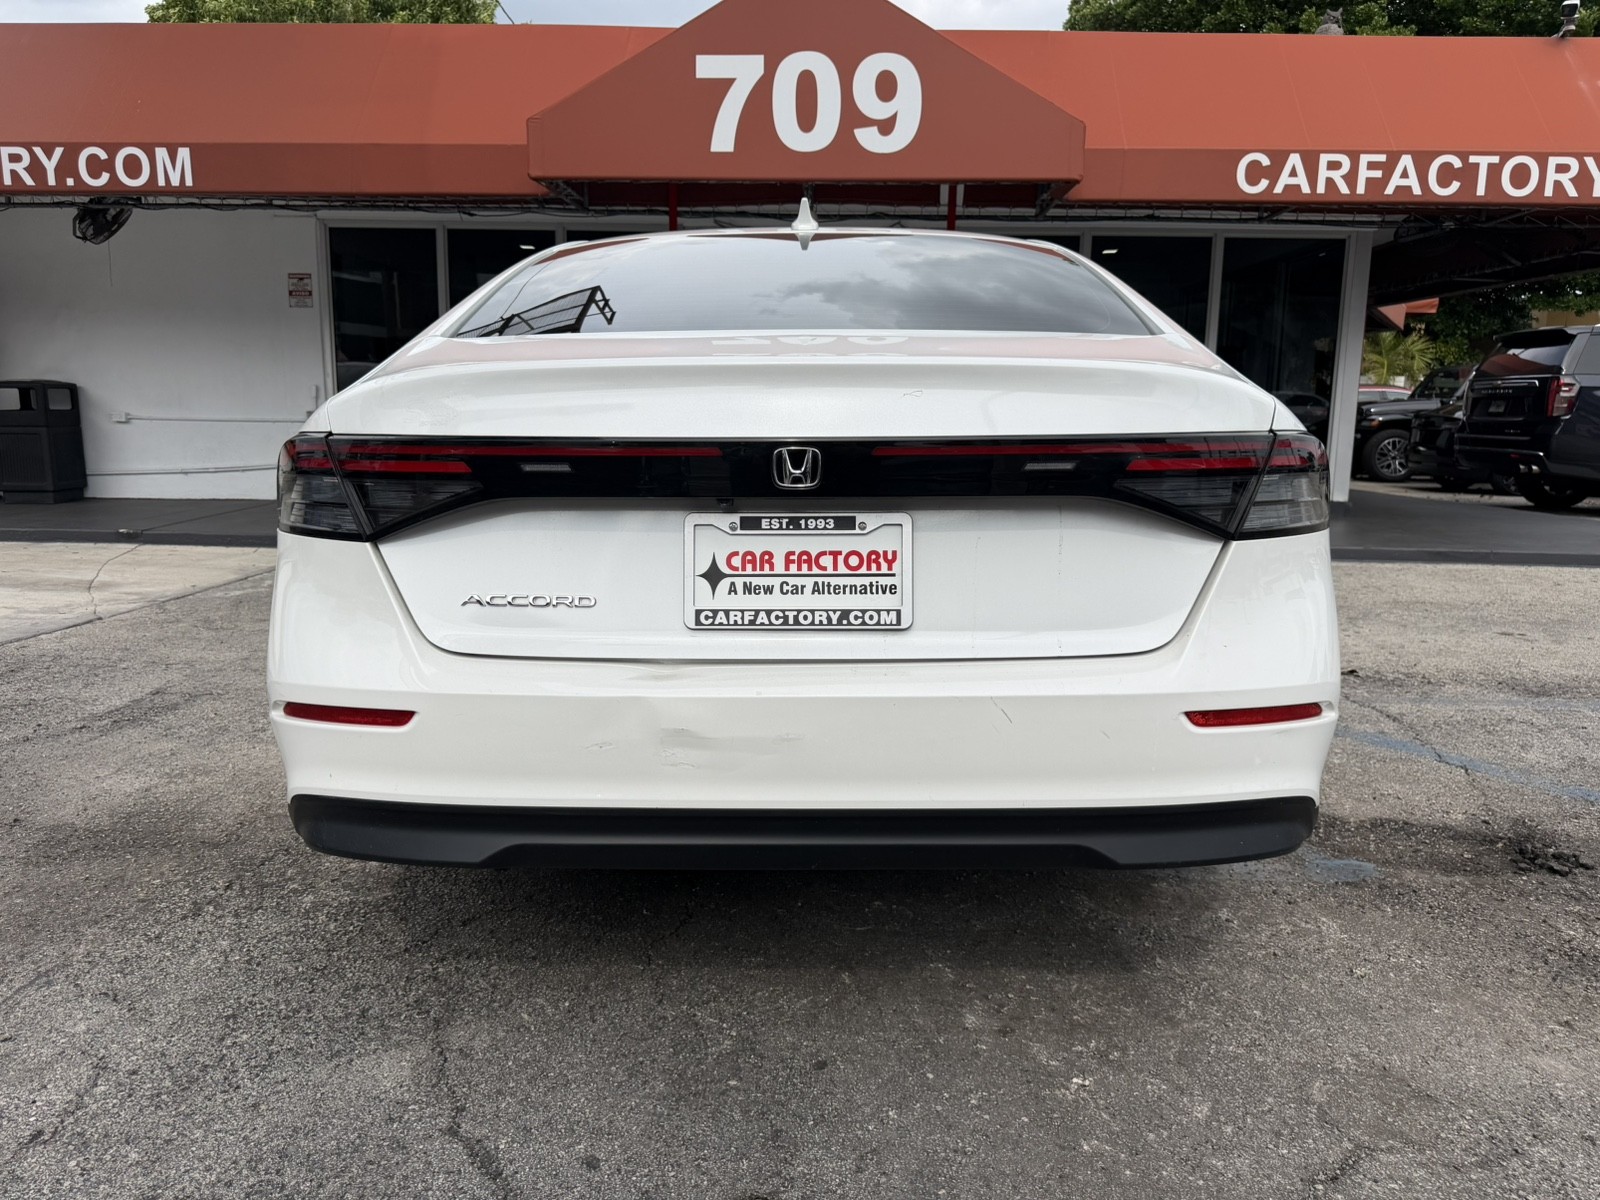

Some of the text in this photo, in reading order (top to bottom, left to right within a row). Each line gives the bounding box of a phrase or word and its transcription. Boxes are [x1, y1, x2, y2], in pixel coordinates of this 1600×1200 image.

[695, 50, 922, 154] 709
[0, 146, 193, 187] RY.COM
[1236, 152, 1600, 197] CARFACTORY
[761, 518, 835, 529] EST. 1993
[725, 549, 898, 572] CAR FACTORY
[727, 580, 897, 596] A New Car Alternative
[461, 594, 597, 607] ACCORD
[699, 610, 898, 626] CARFACTORY.COM
